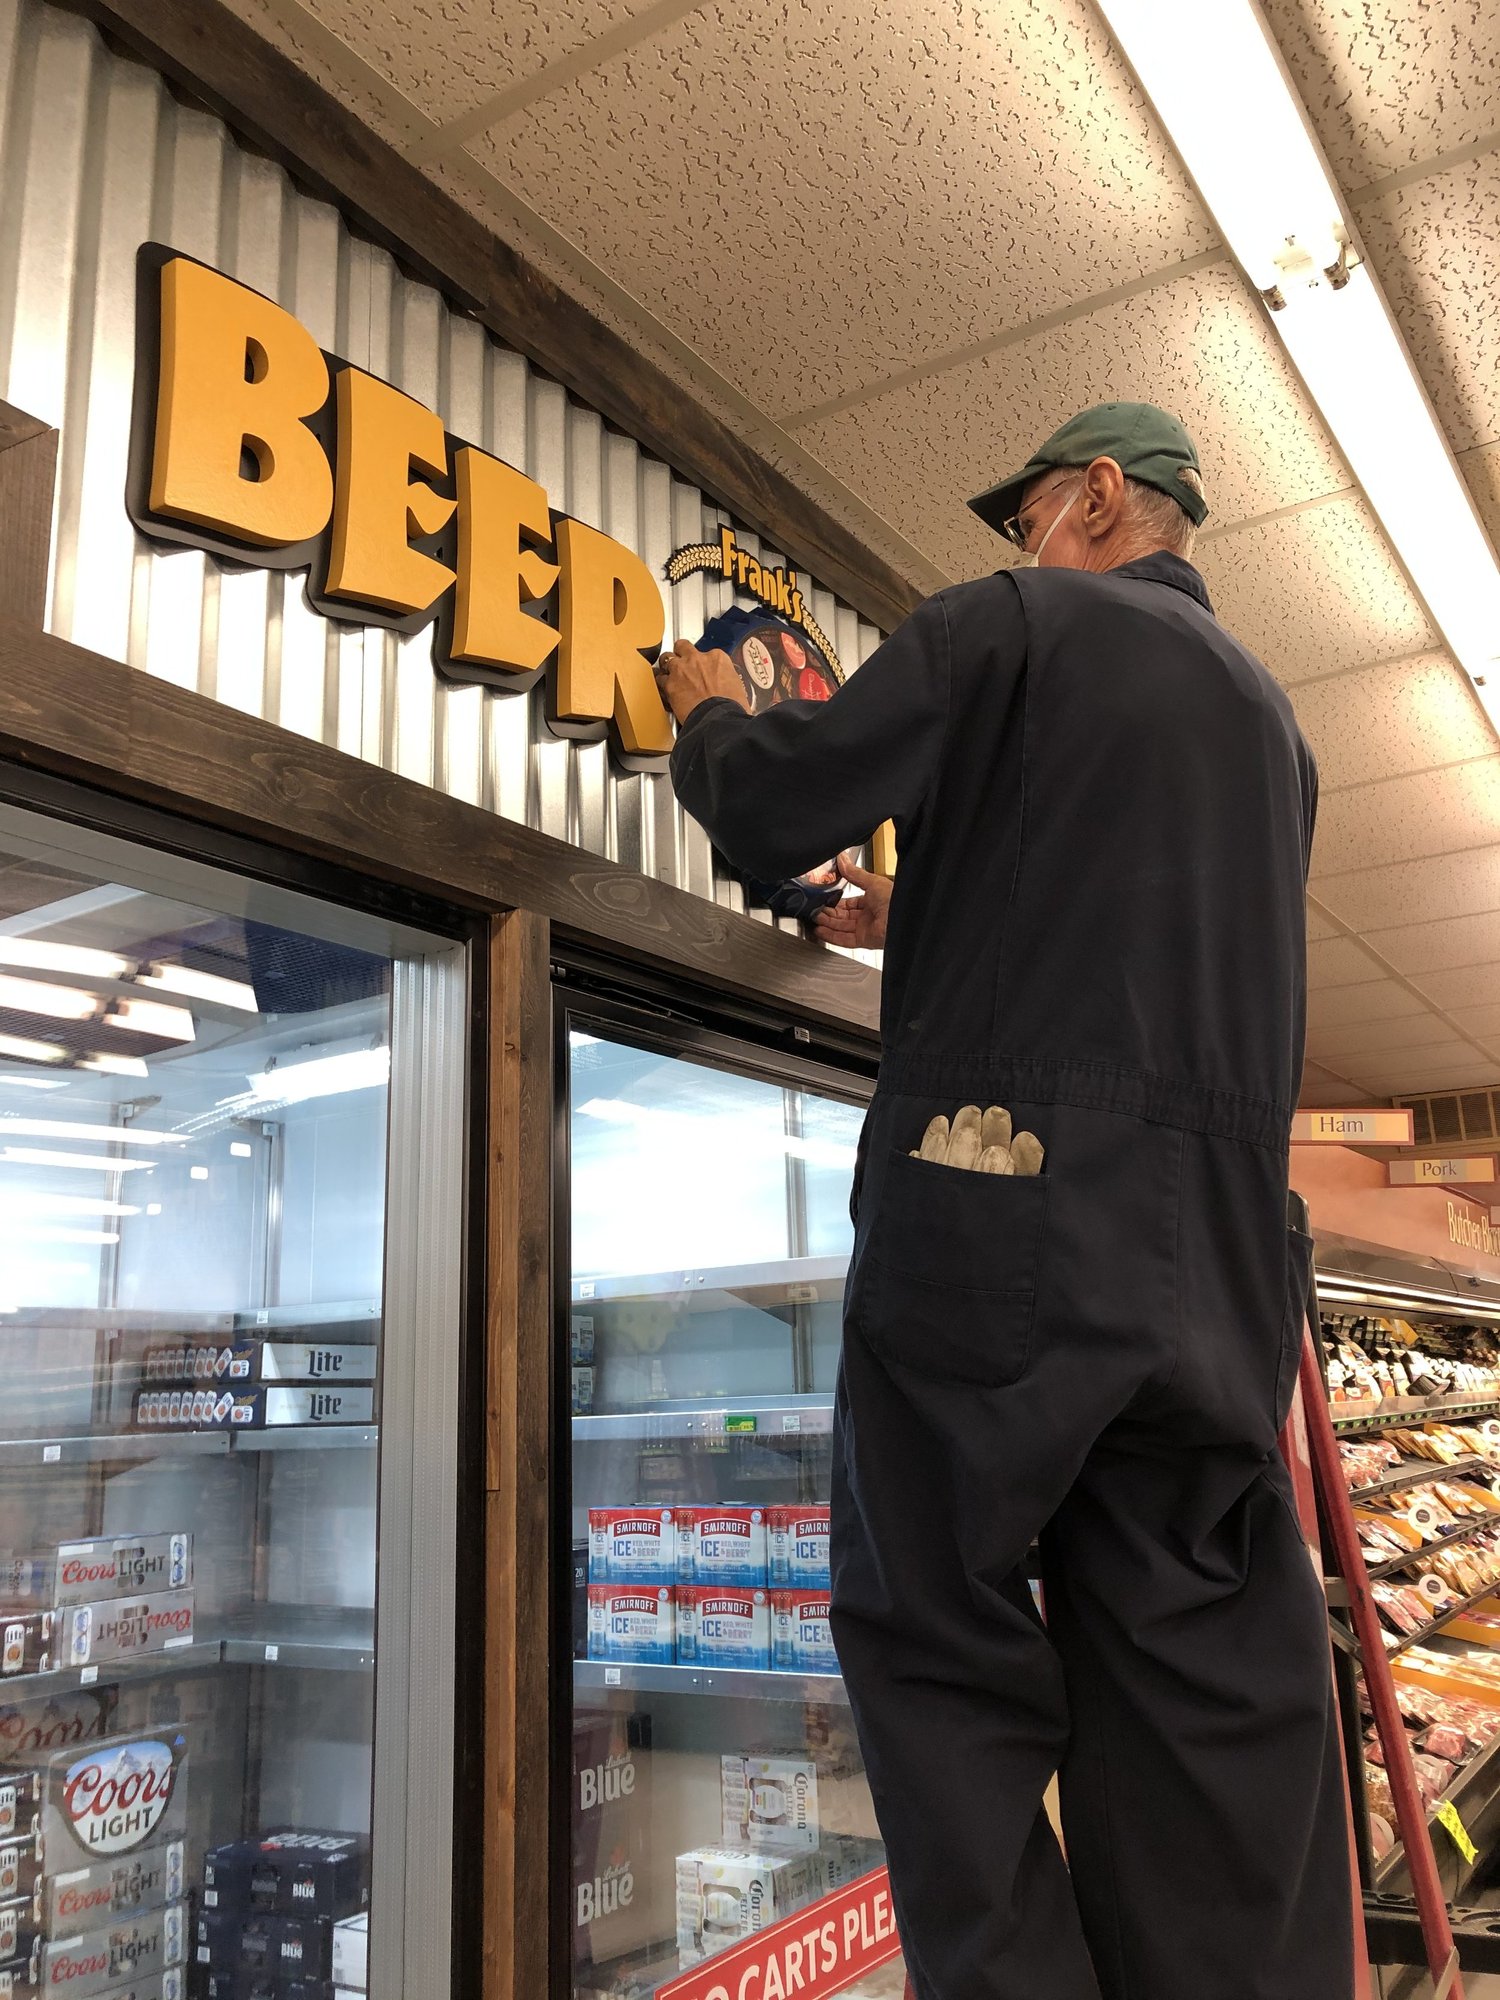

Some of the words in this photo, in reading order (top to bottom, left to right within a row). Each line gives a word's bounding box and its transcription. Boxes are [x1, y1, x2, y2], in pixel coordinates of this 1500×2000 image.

[150, 257, 676, 754] BEER
[721, 527, 802, 622] Frank's
[1320, 1116, 1364, 1133] Ham
[1422, 1161, 1457, 1177] Pork
[307, 1350, 343, 1377] Lite
[310, 1393, 342, 1421] Lite
[616, 1523, 657, 1534] SMIRNOFF
[704, 1521, 747, 1534] SMIRNOFF
[613, 1540, 631, 1556] ICE
[700, 1540, 720, 1557] ICE
[796, 1541, 817, 1558] ICE
[63, 1560, 117, 1584] Coors
[119, 1555, 165, 1576] LIGHT
[614, 1599, 655, 1611] SMIRNOFF
[705, 1601, 749, 1614] SMIRNOFF
[98, 1616, 144, 1640] LIGHT
[147, 1607, 191, 1632] Coors
[612, 1617, 630, 1633] ICE
[702, 1620, 722, 1637] ICE
[800, 1624, 820, 1642] ICE
[63, 1763, 174, 1822] Coors
[580, 1763, 635, 1810] Blue
[794, 1772, 808, 1830] Corona
[89, 1807, 153, 1844] LIGHT
[58, 1885, 113, 1916] Coors
[293, 1881, 315, 1898] Blue
[577, 1873, 633, 1926] Blue
[281, 1942, 302, 1959] Blue
[738, 1921, 838, 2000] CARTS
[52, 1952, 108, 1984] Coors
